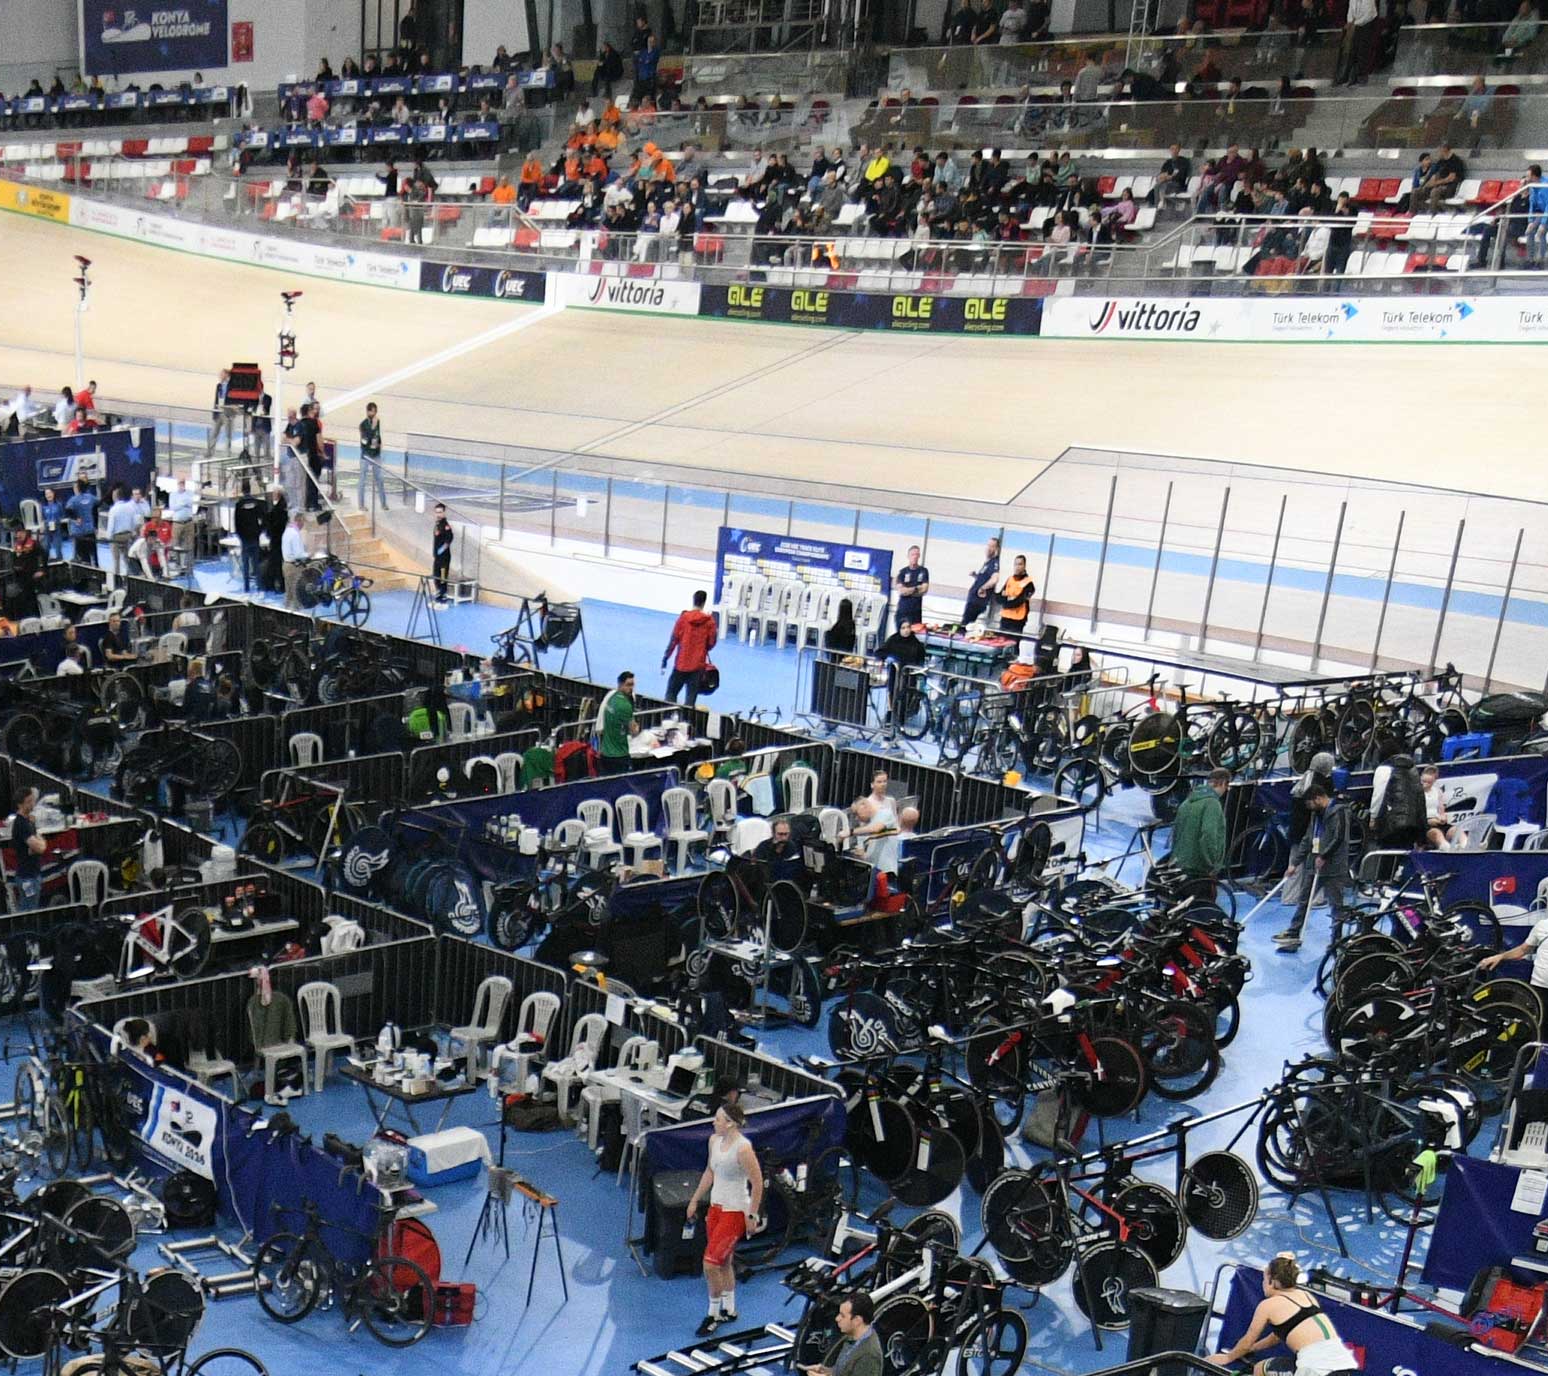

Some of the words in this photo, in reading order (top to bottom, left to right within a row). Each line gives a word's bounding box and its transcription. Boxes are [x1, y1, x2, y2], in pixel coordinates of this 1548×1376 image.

[152, 10, 190, 24] KONYA
[152, 22, 211, 38] VELODROME
[453, 274, 471, 288] UEC
[506, 279, 525, 292] UEC
[607, 279, 665, 305] vittoria
[1116, 301, 1201, 334] vittoria
[1272, 311, 1294, 324] Türk
[1297, 311, 1340, 325] Telekom
[1382, 310, 1404, 324] Türk
[1407, 311, 1453, 324] Telekom
[1519, 310, 1545, 323] Türk
